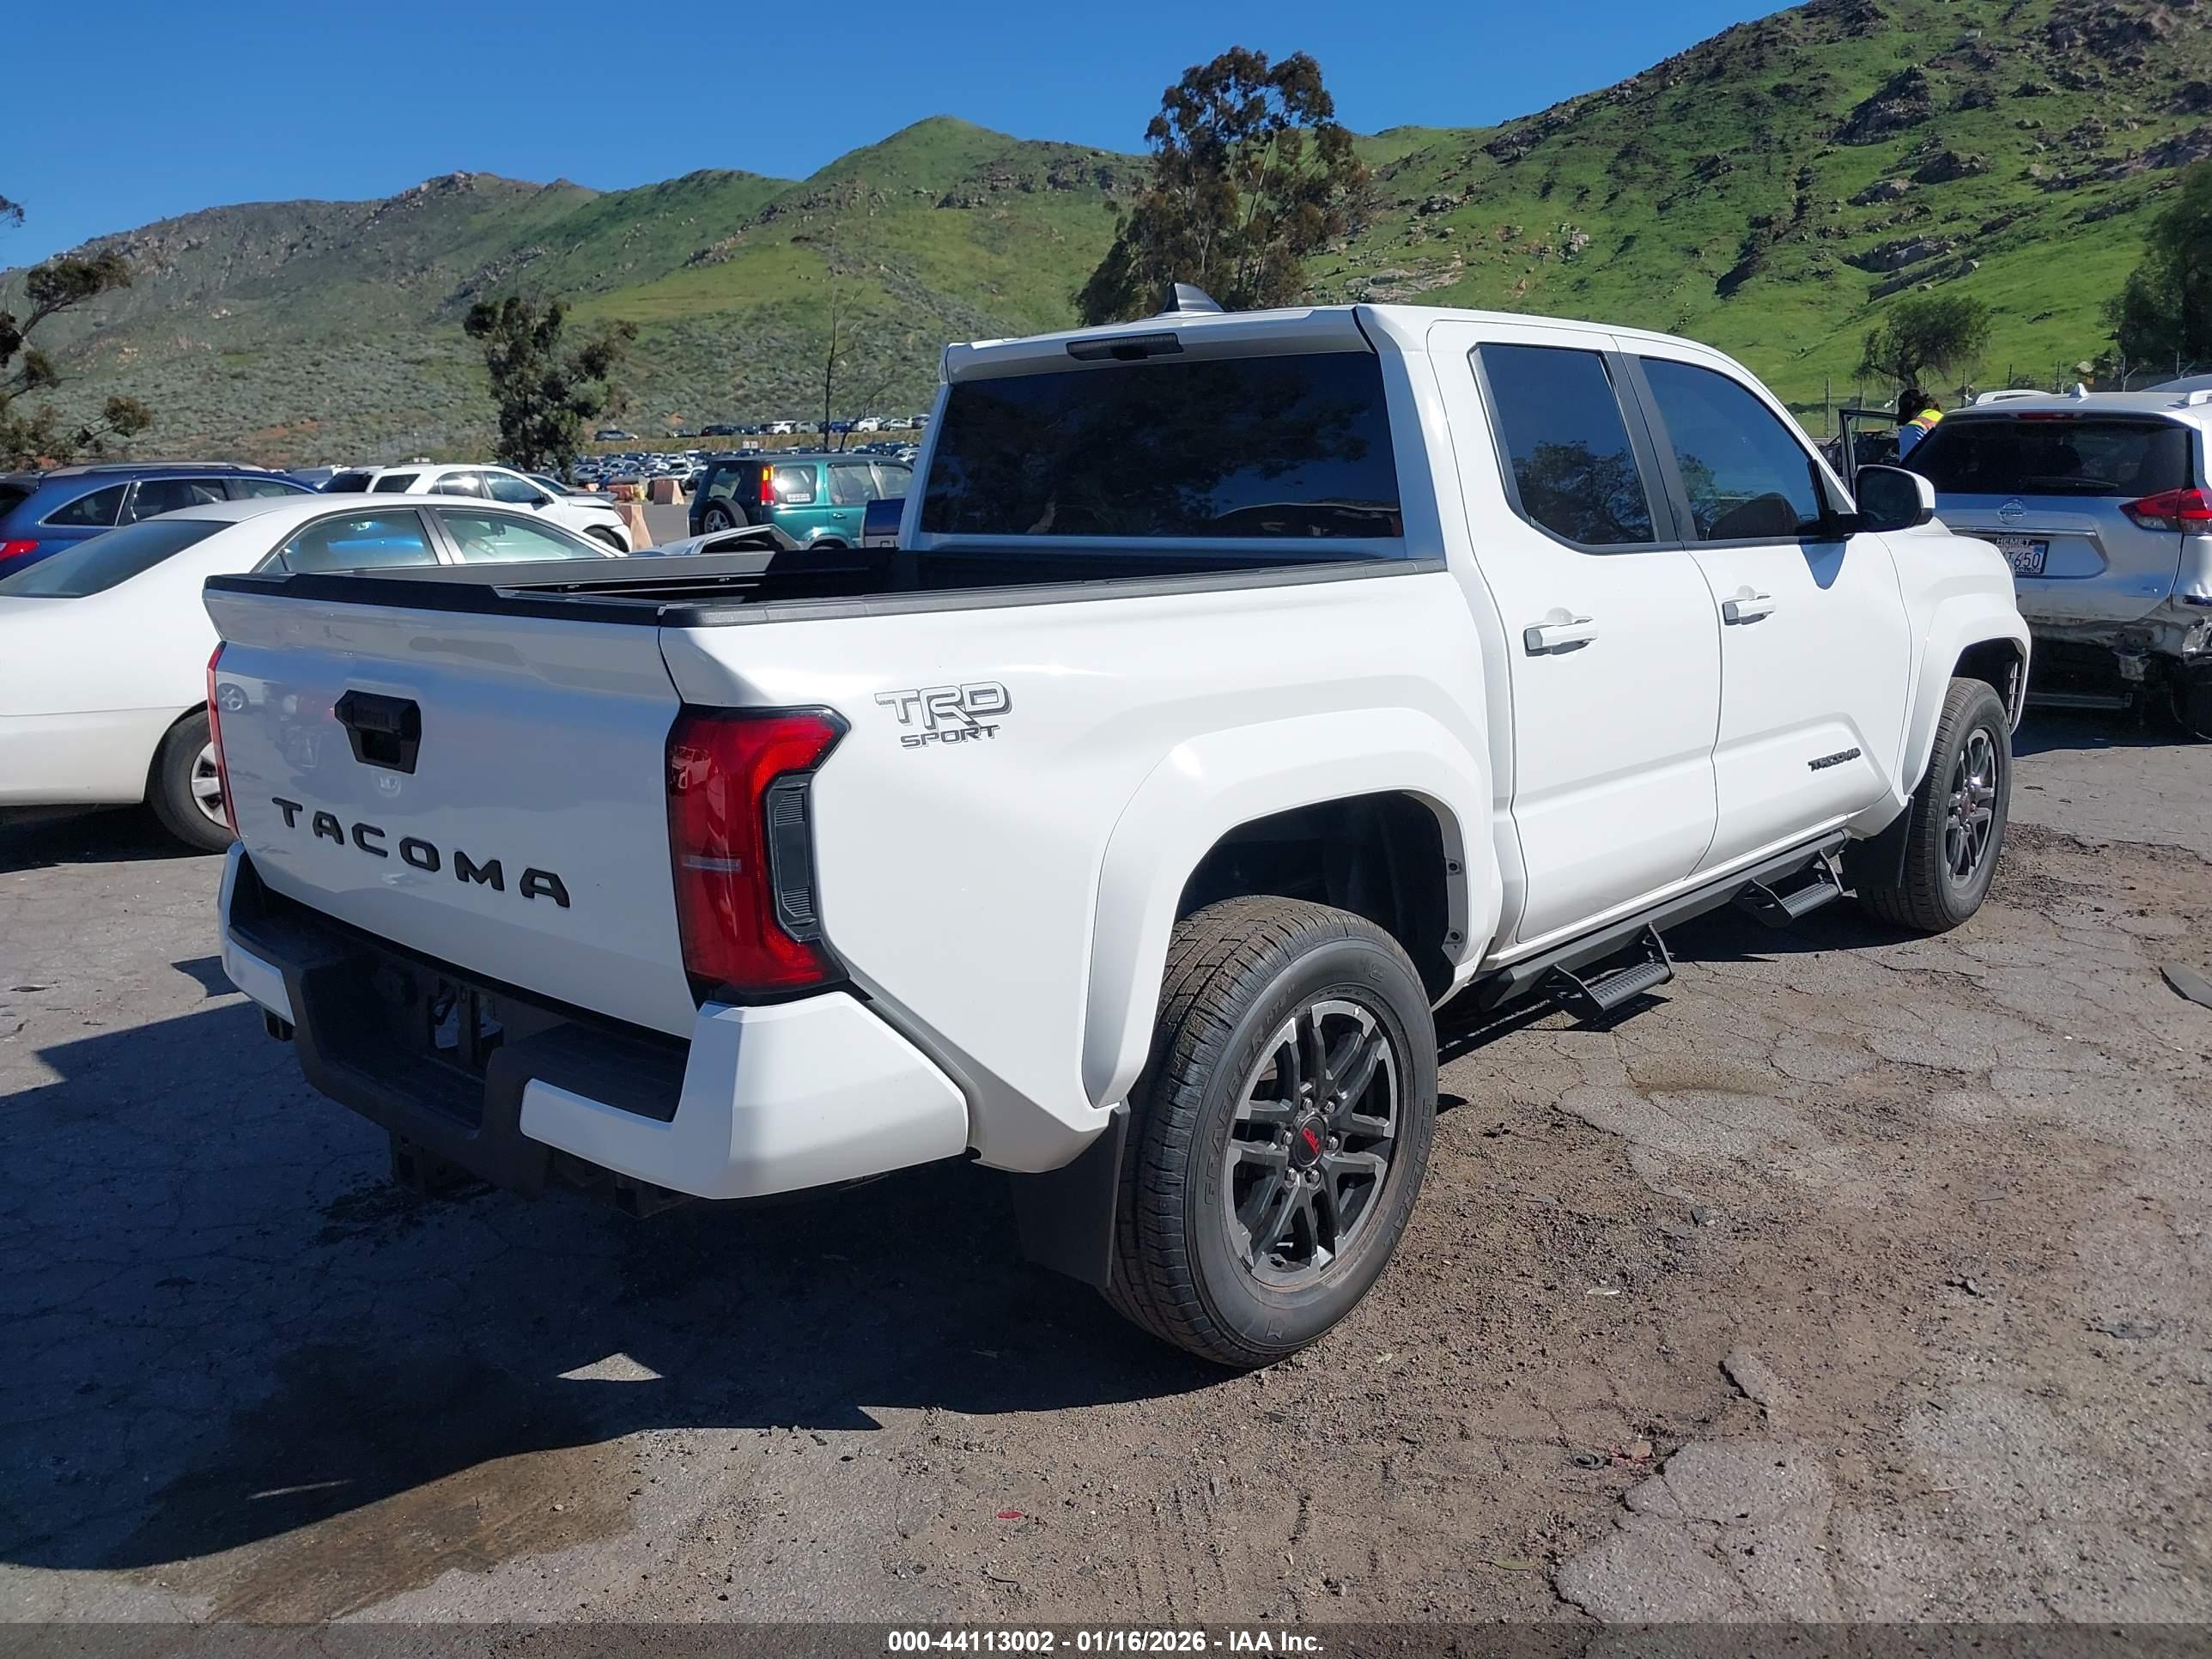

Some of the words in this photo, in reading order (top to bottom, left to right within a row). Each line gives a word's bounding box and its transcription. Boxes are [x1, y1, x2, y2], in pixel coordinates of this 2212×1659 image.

[873, 680, 1013, 731] TRD
[900, 724, 1001, 749] SPORT
[271, 796, 571, 908] TACOMA
